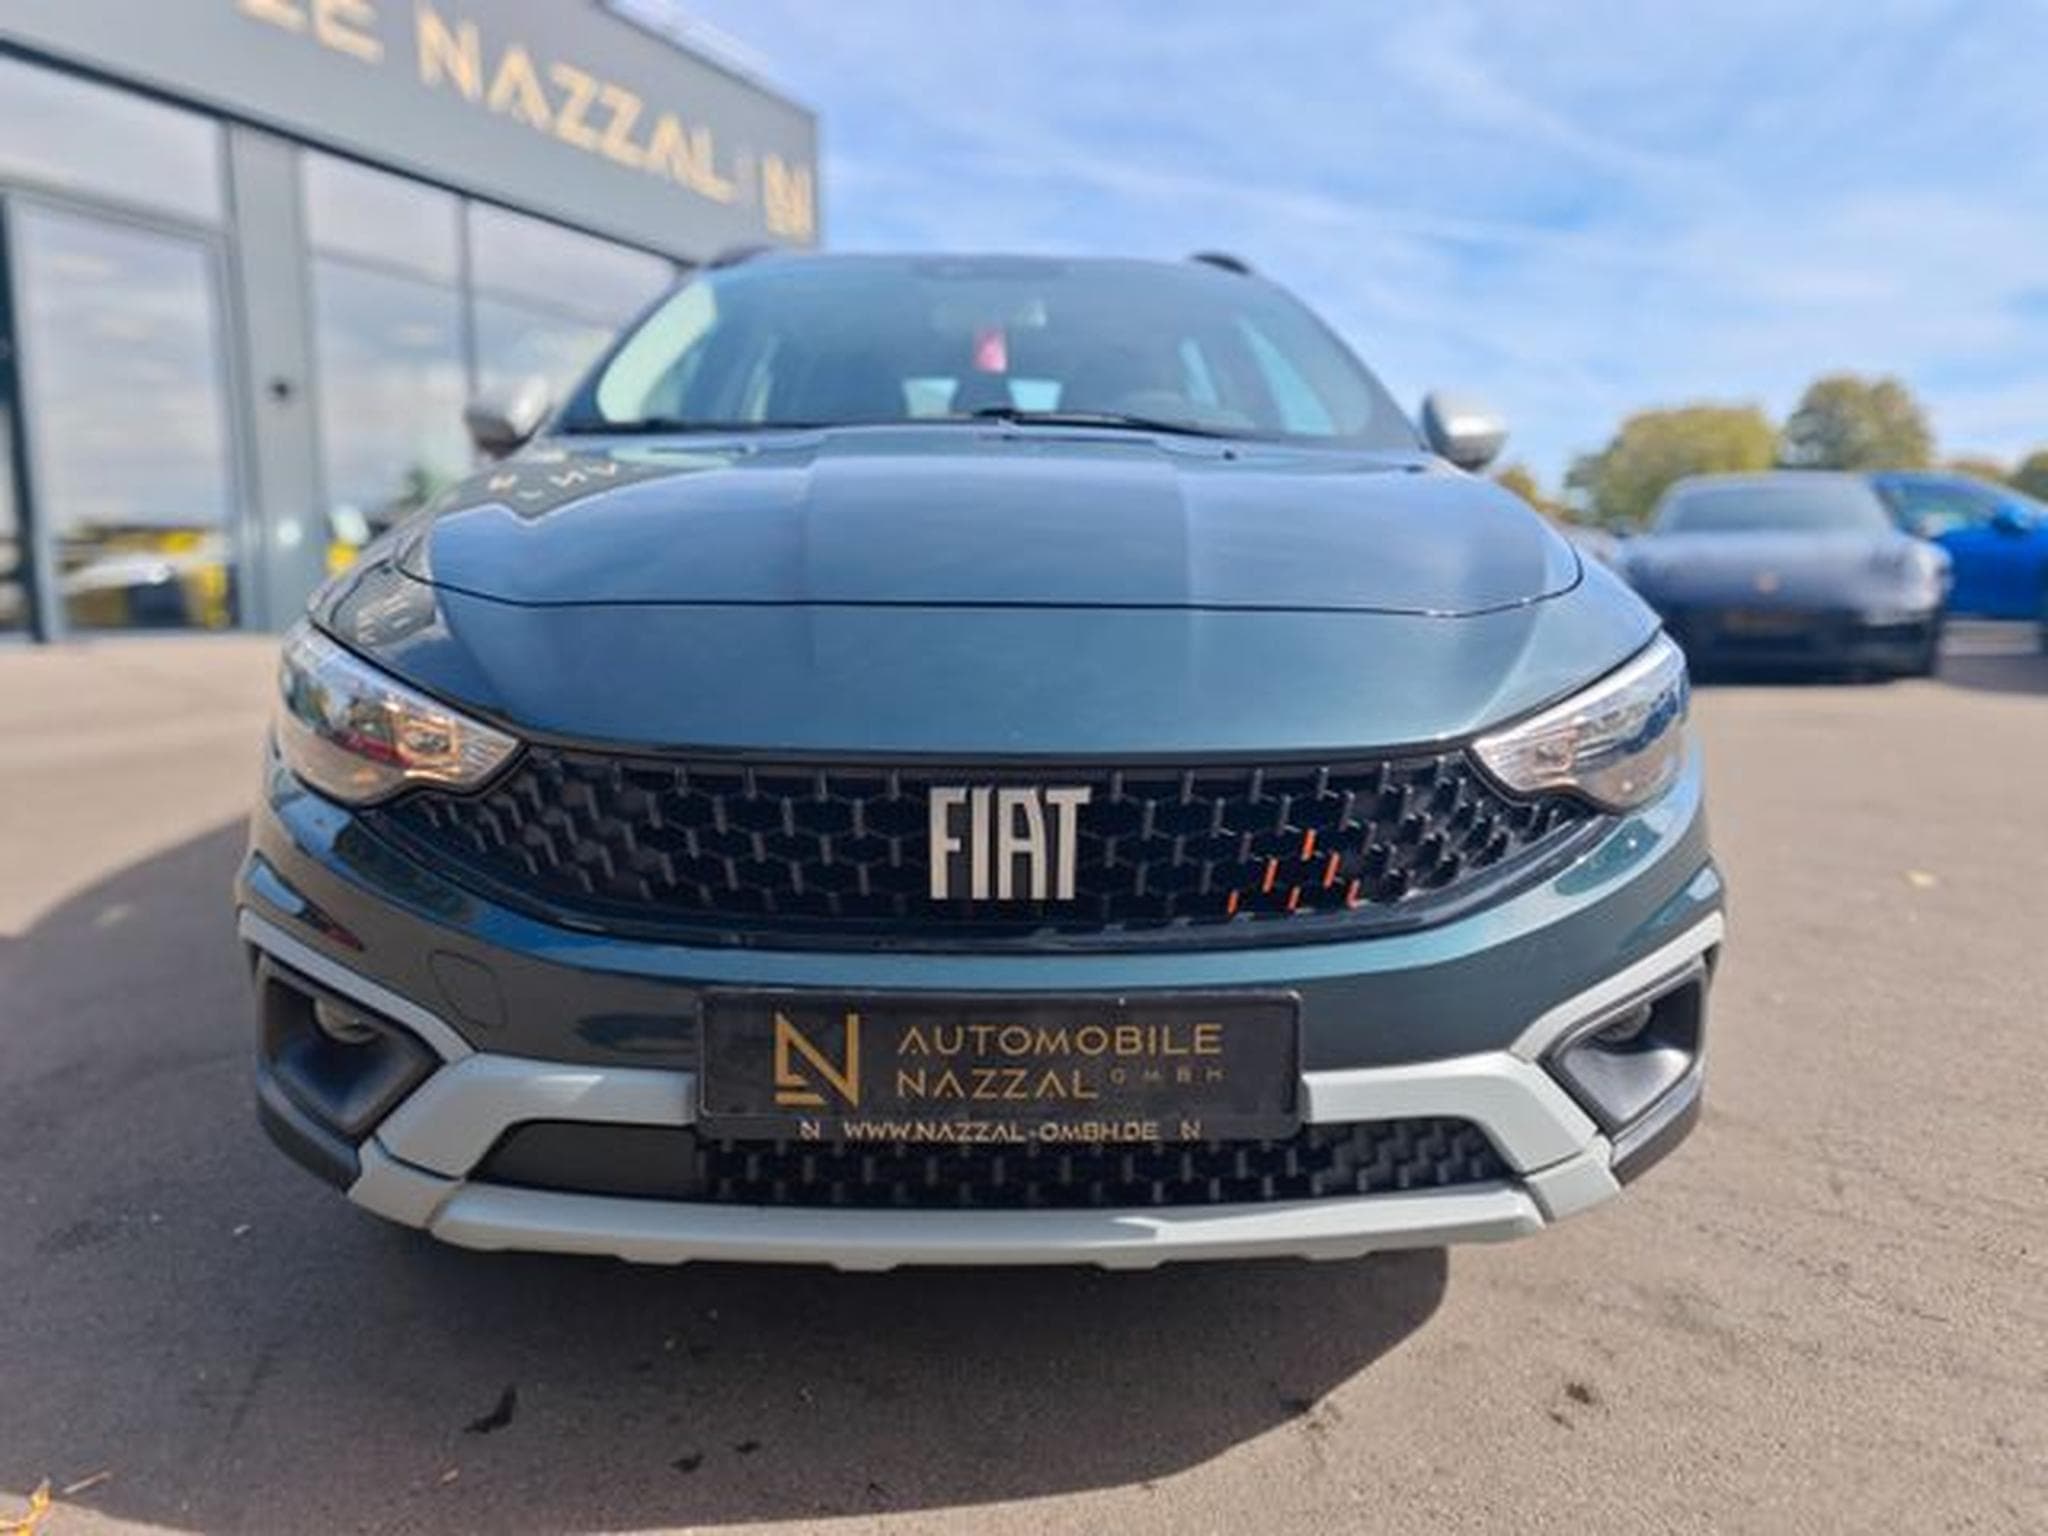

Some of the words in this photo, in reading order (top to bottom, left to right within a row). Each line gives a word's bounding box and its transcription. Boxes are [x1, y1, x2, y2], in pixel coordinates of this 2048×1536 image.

[416, 8, 736, 204] NAZZAL
[929, 786, 1092, 900] FIAT
[898, 1023, 1223, 1056] AUTOMOBILE
[897, 1067, 1099, 1100] NAZZAL
